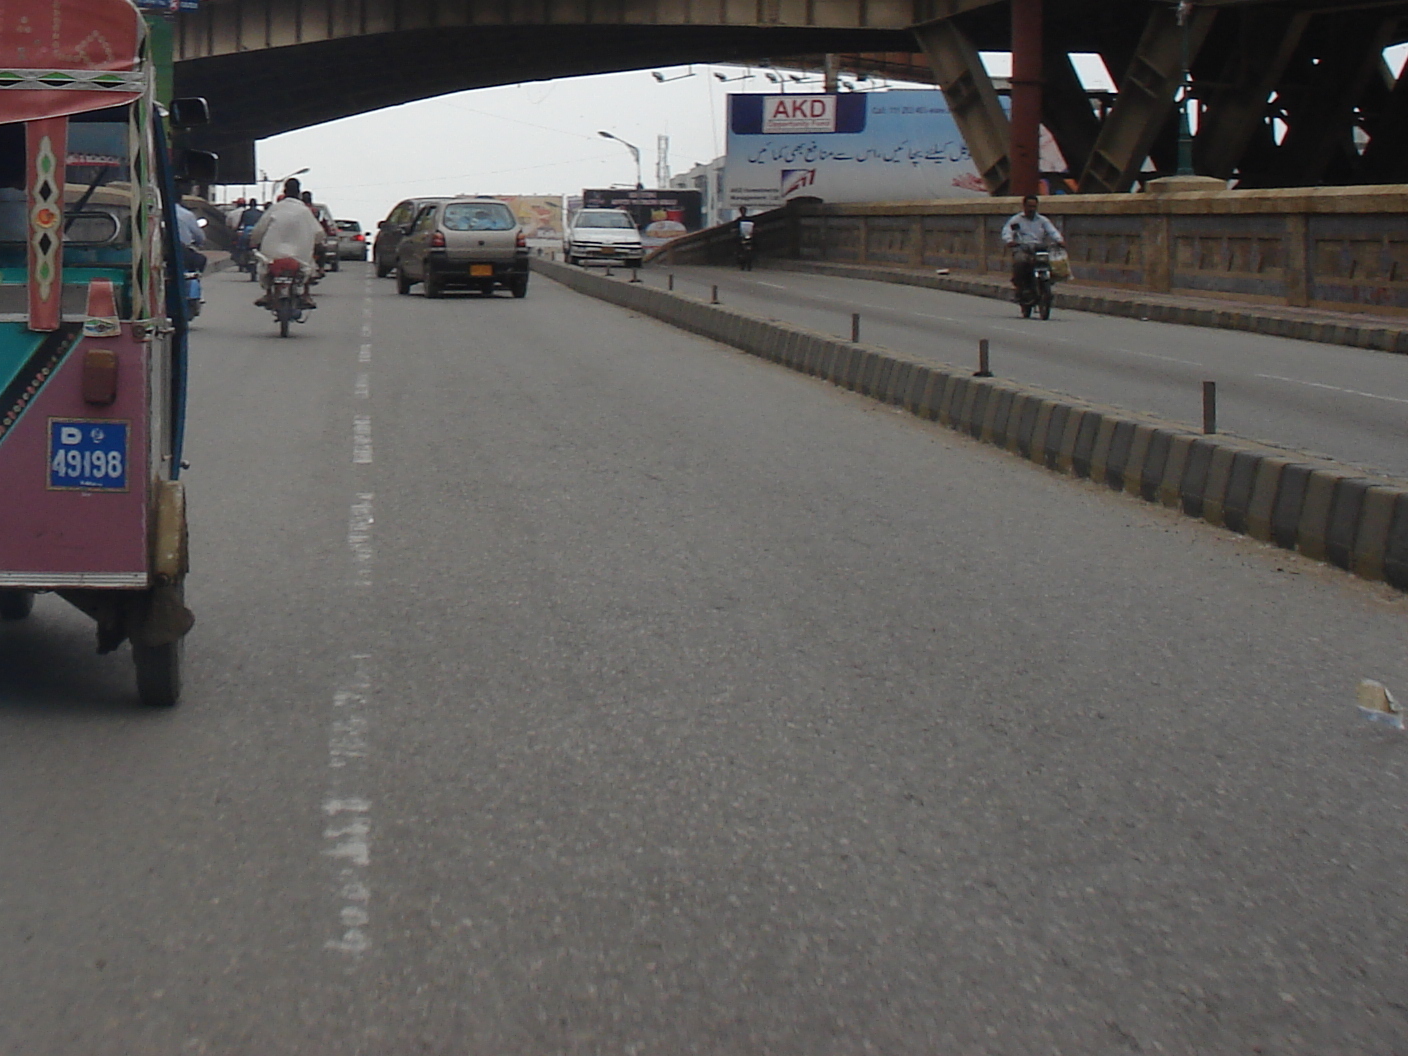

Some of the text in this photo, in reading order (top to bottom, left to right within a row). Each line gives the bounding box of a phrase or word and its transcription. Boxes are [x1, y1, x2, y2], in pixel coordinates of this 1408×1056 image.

[773, 99, 826, 118] AKD
[60, 426, 82, 445] D
[52, 449, 122, 479] 49198
